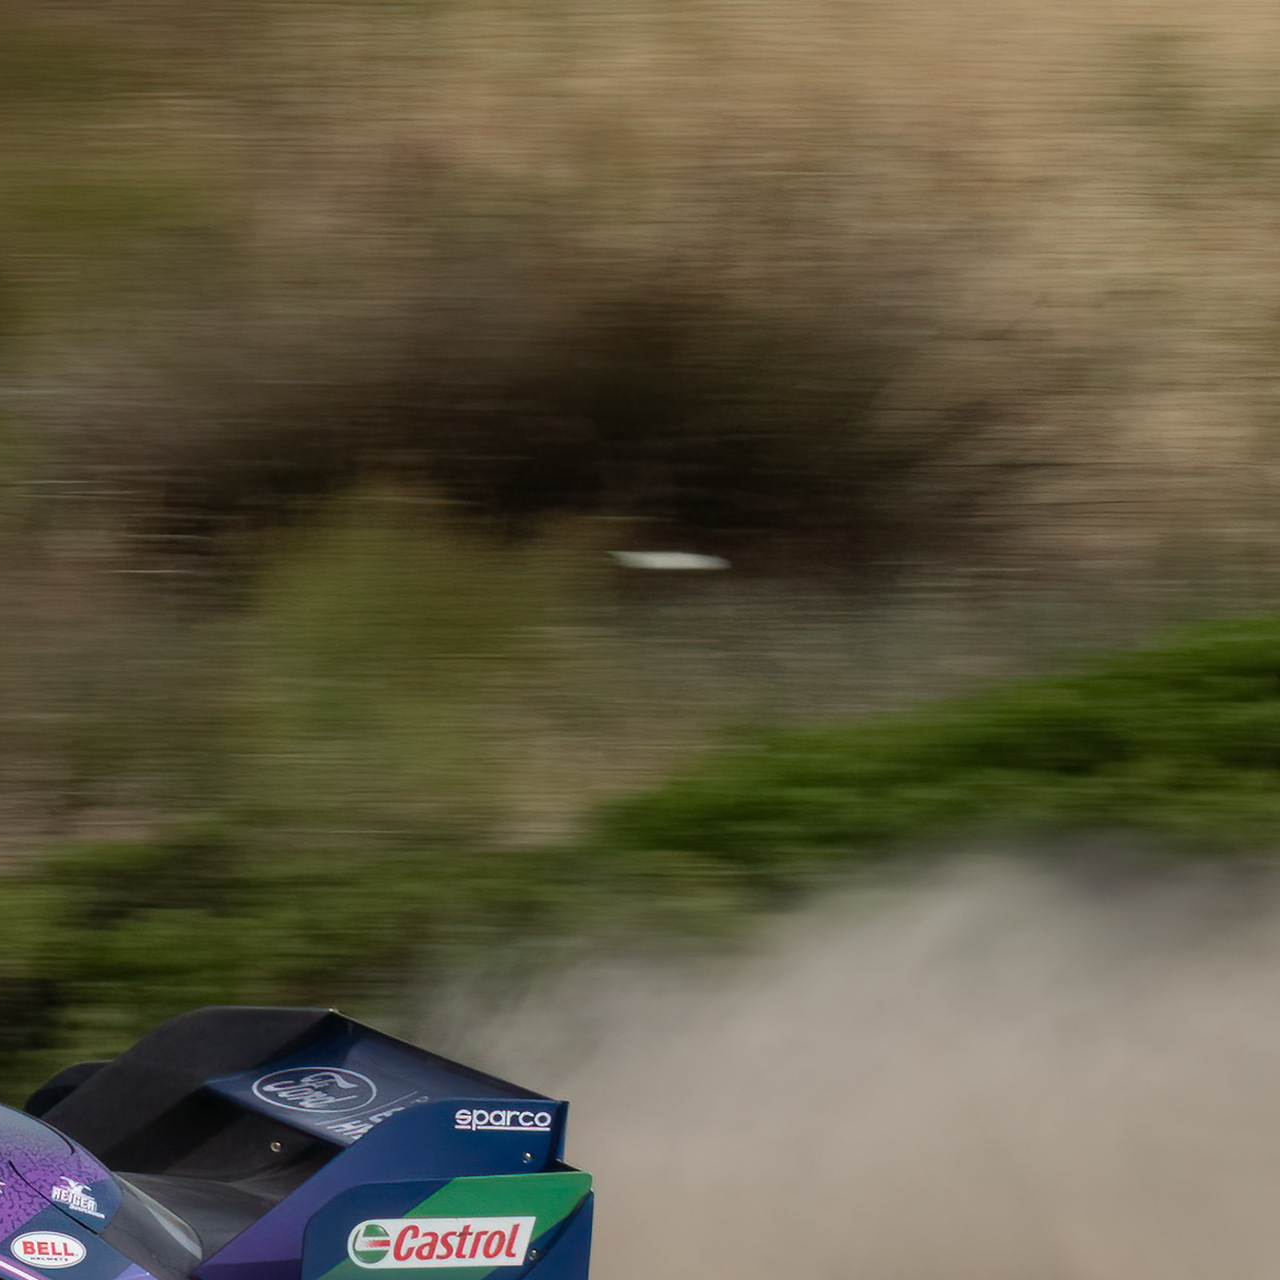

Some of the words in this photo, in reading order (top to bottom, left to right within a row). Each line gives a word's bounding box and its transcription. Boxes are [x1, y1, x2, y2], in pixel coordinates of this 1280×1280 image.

[262, 1071, 358, 1109] Ford
[454, 1107, 552, 1131] sparco
[22, 1240, 75, 1256] BELL
[392, 1222, 519, 1263] Castrol
